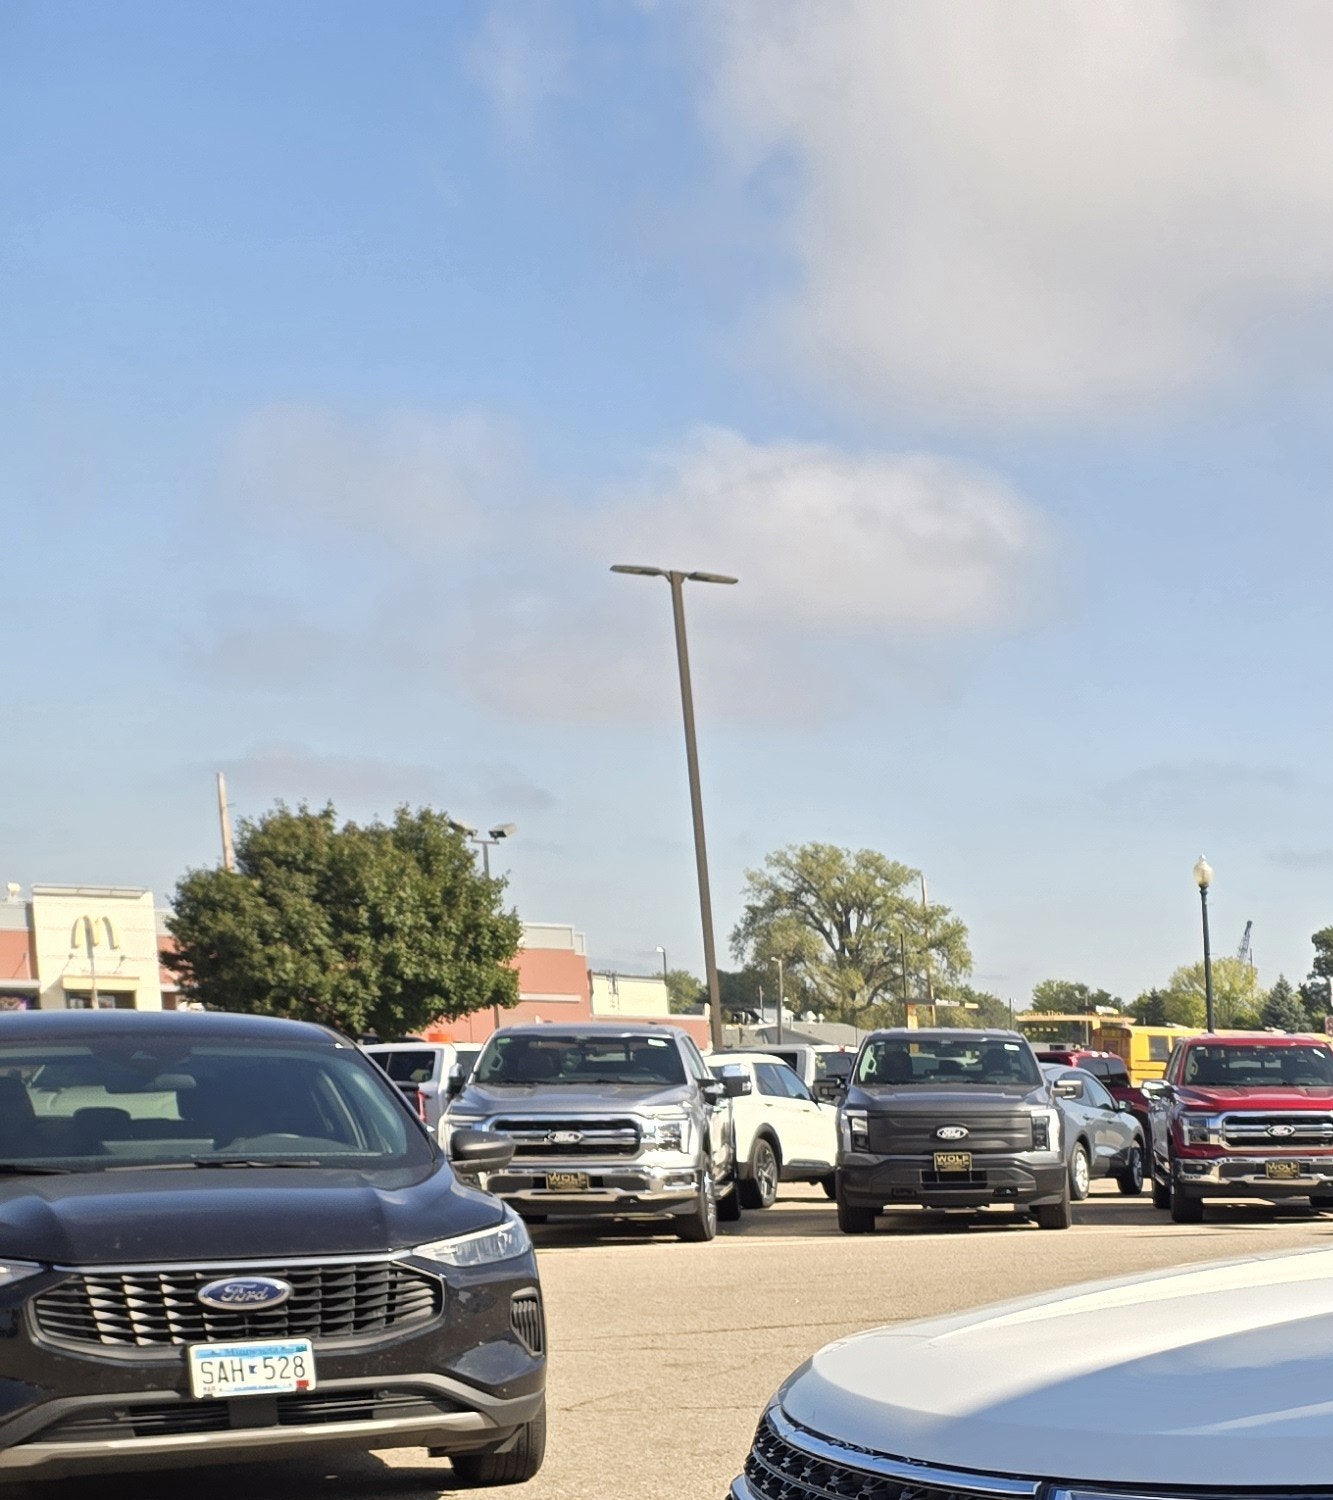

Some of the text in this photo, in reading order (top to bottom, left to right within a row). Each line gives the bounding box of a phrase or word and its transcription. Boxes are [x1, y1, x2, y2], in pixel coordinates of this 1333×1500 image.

[220, 1283, 269, 1302] Ford
[201, 1355, 306, 1385] SAH 528
